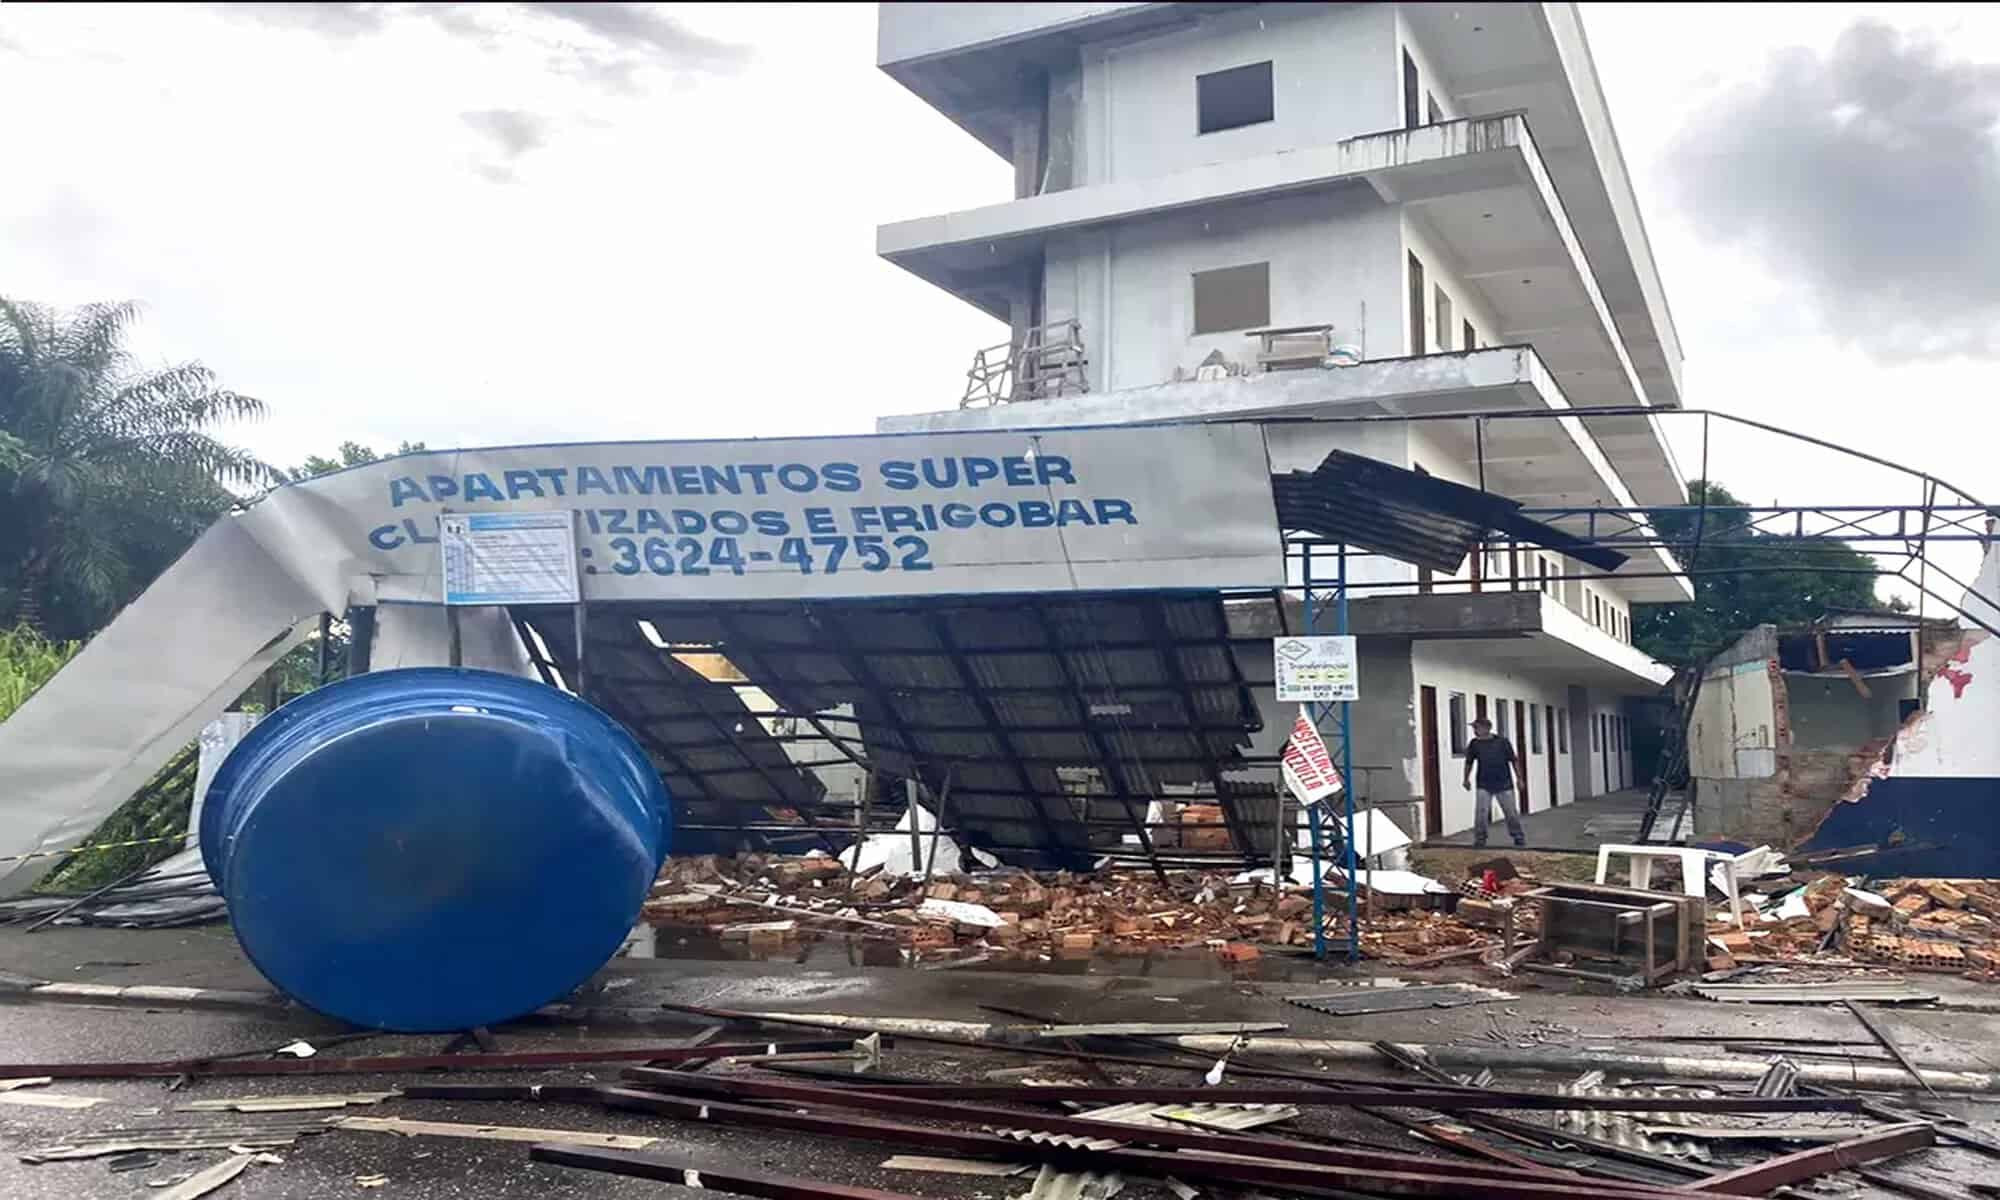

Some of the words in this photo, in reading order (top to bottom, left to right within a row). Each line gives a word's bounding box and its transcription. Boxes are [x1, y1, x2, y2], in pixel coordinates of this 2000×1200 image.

[389, 462, 862, 507] APARTAMENTOS
[879, 455, 1077, 491] SUPER
[368, 508, 791, 550] CLIZADOS
[805, 506, 837, 535] E
[851, 498, 1139, 533] FRIGOBAR
